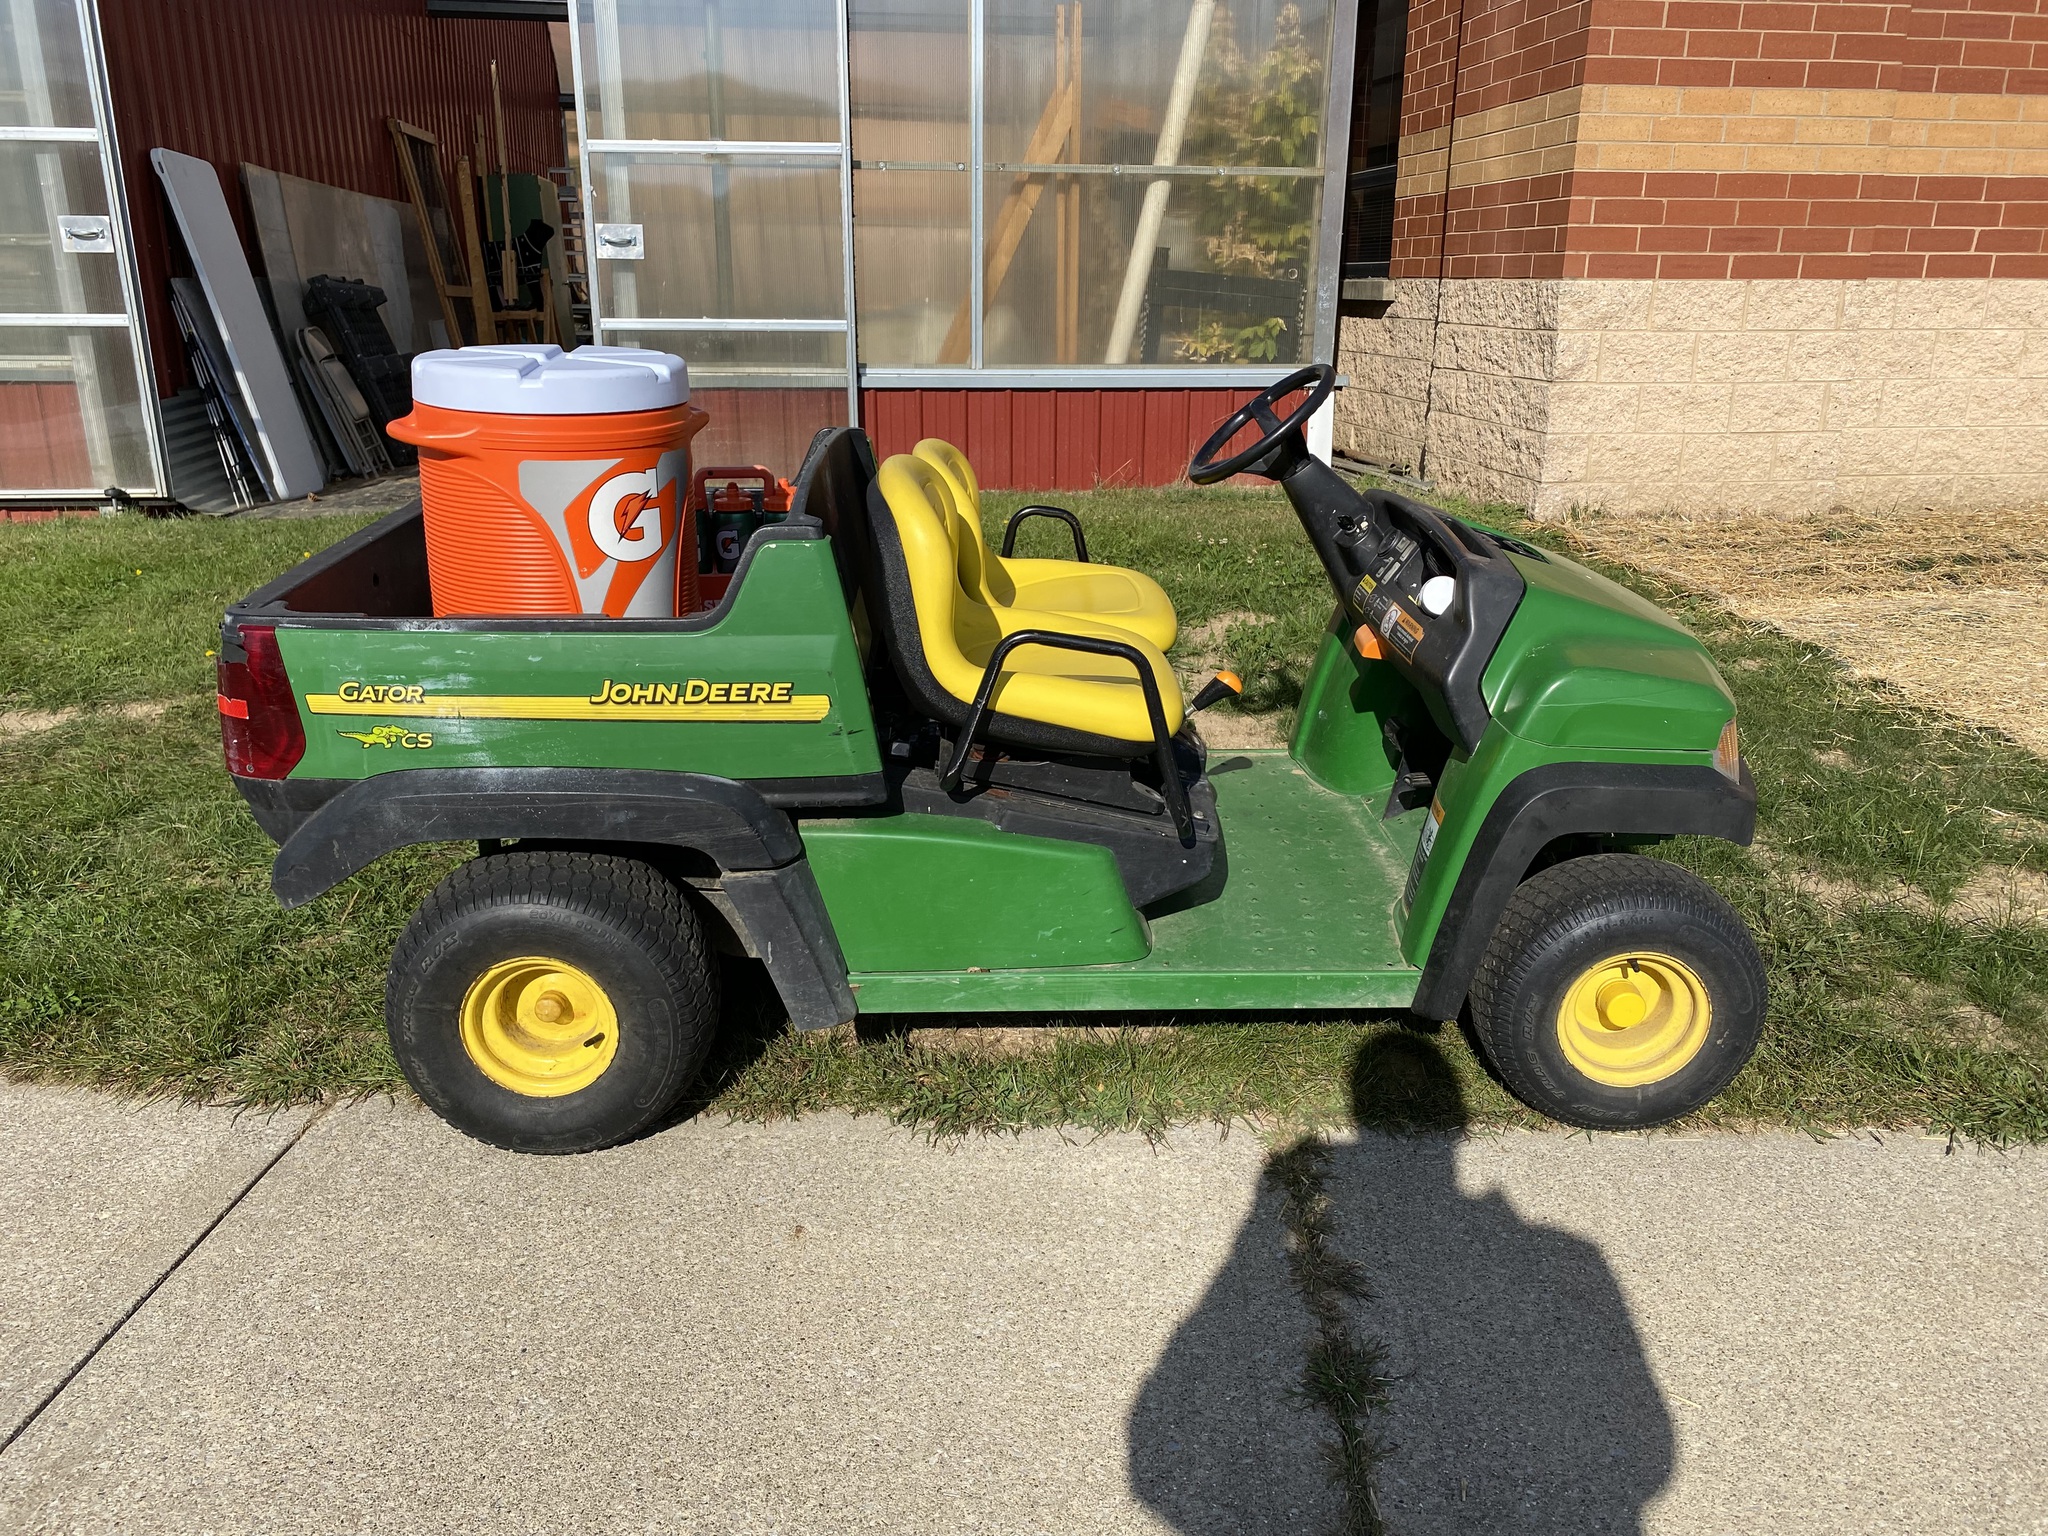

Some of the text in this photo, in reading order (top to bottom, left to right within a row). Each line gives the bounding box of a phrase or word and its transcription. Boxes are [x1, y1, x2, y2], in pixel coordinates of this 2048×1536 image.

[587, 467, 663, 562] G
[716, 530, 740, 560] G
[339, 681, 425, 703] GATOR
[589, 679, 794, 704] JOHN DEERE
[401, 732, 433, 749] CS
